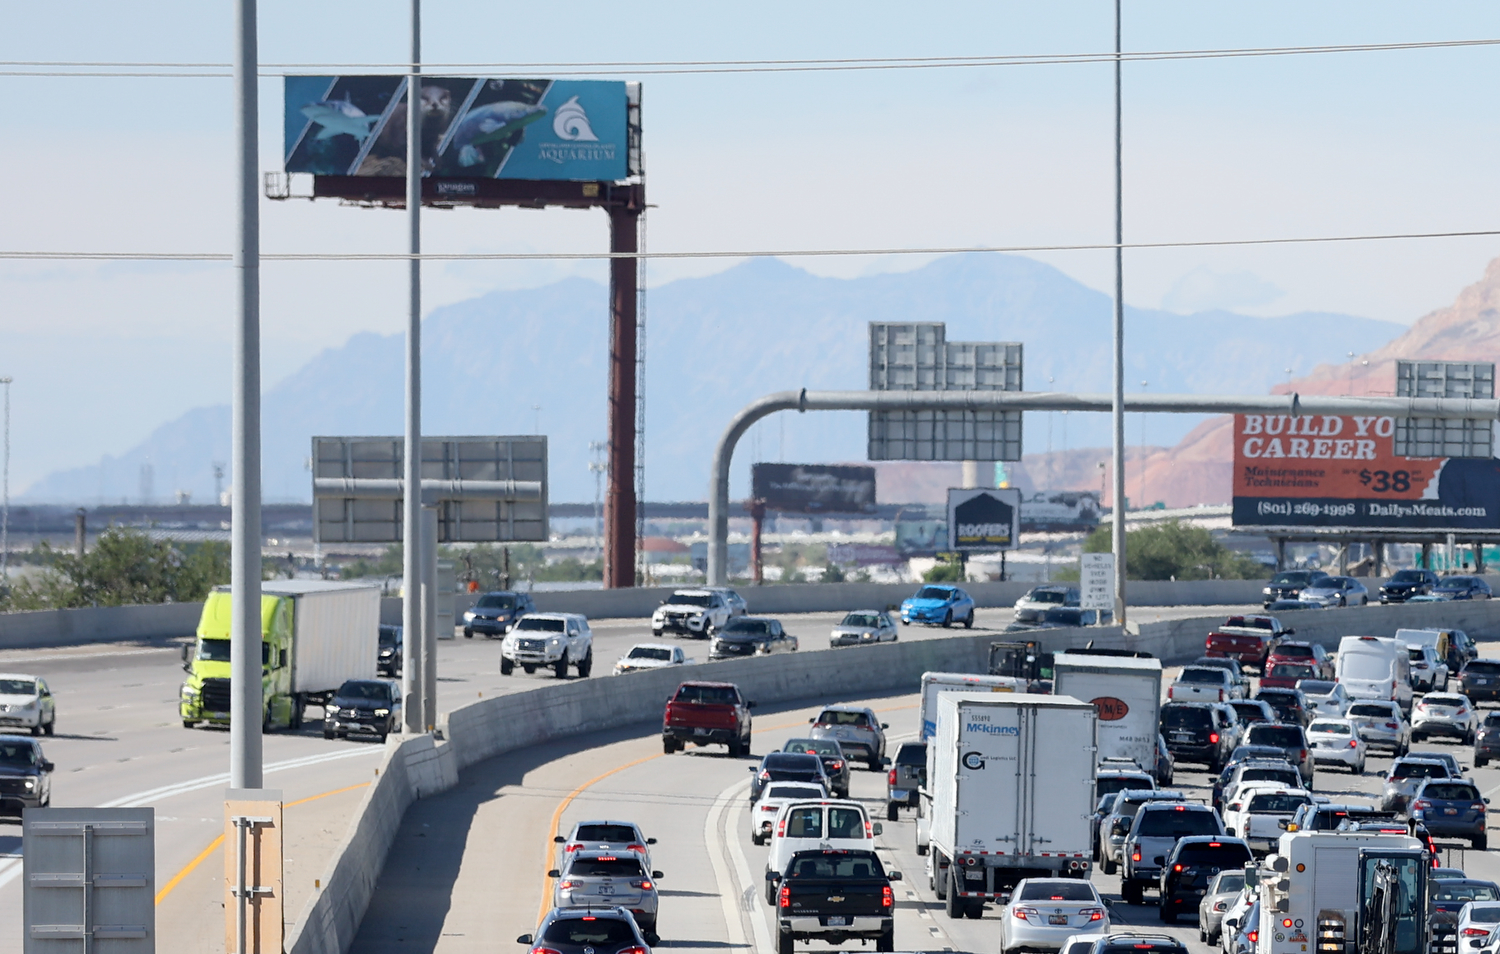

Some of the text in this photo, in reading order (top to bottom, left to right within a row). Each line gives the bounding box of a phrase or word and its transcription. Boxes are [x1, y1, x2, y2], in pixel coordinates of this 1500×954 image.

[538, 149, 616, 164] AQUARIUM
[1242, 415, 1395, 437] BUILD YO
[1242, 437, 1377, 460] CAREER
[1244, 466, 1326, 477] Maintenance
[1359, 468, 1411, 493] $38
[1244, 477, 1320, 488] Technicians
[1257, 501, 1487, 517] (801) 269-1998 DailysMeats.com
